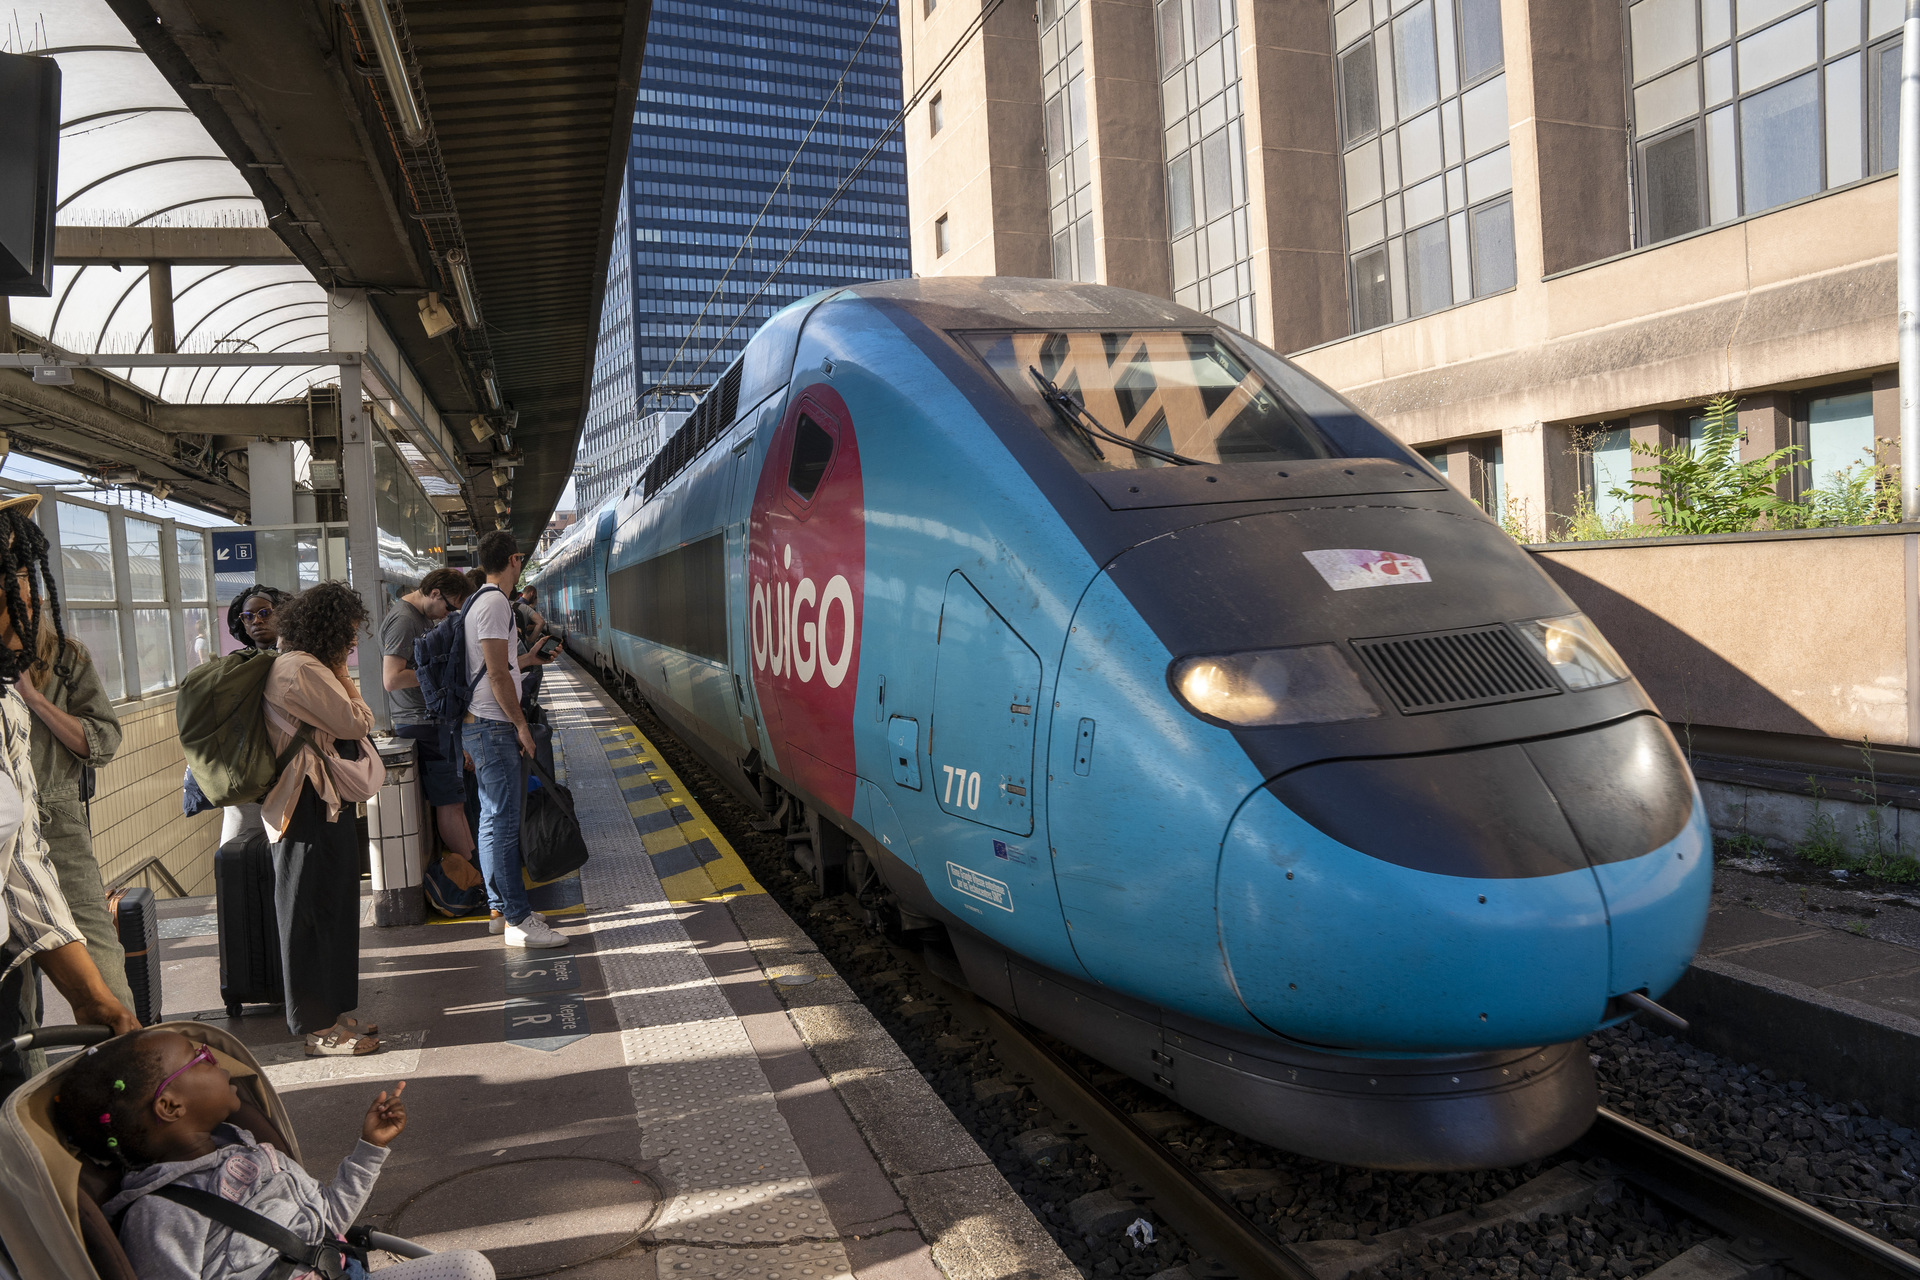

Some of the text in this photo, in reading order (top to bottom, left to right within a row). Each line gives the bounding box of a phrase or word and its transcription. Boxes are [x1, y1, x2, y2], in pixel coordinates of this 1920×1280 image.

[240, 550, 247, 558] B
[943, 765, 980, 811] 770
[511, 969, 548, 979] S
[550, 960, 572, 981] Repère
[512, 1014, 552, 1028] R
[556, 1003, 580, 1029] Repère
